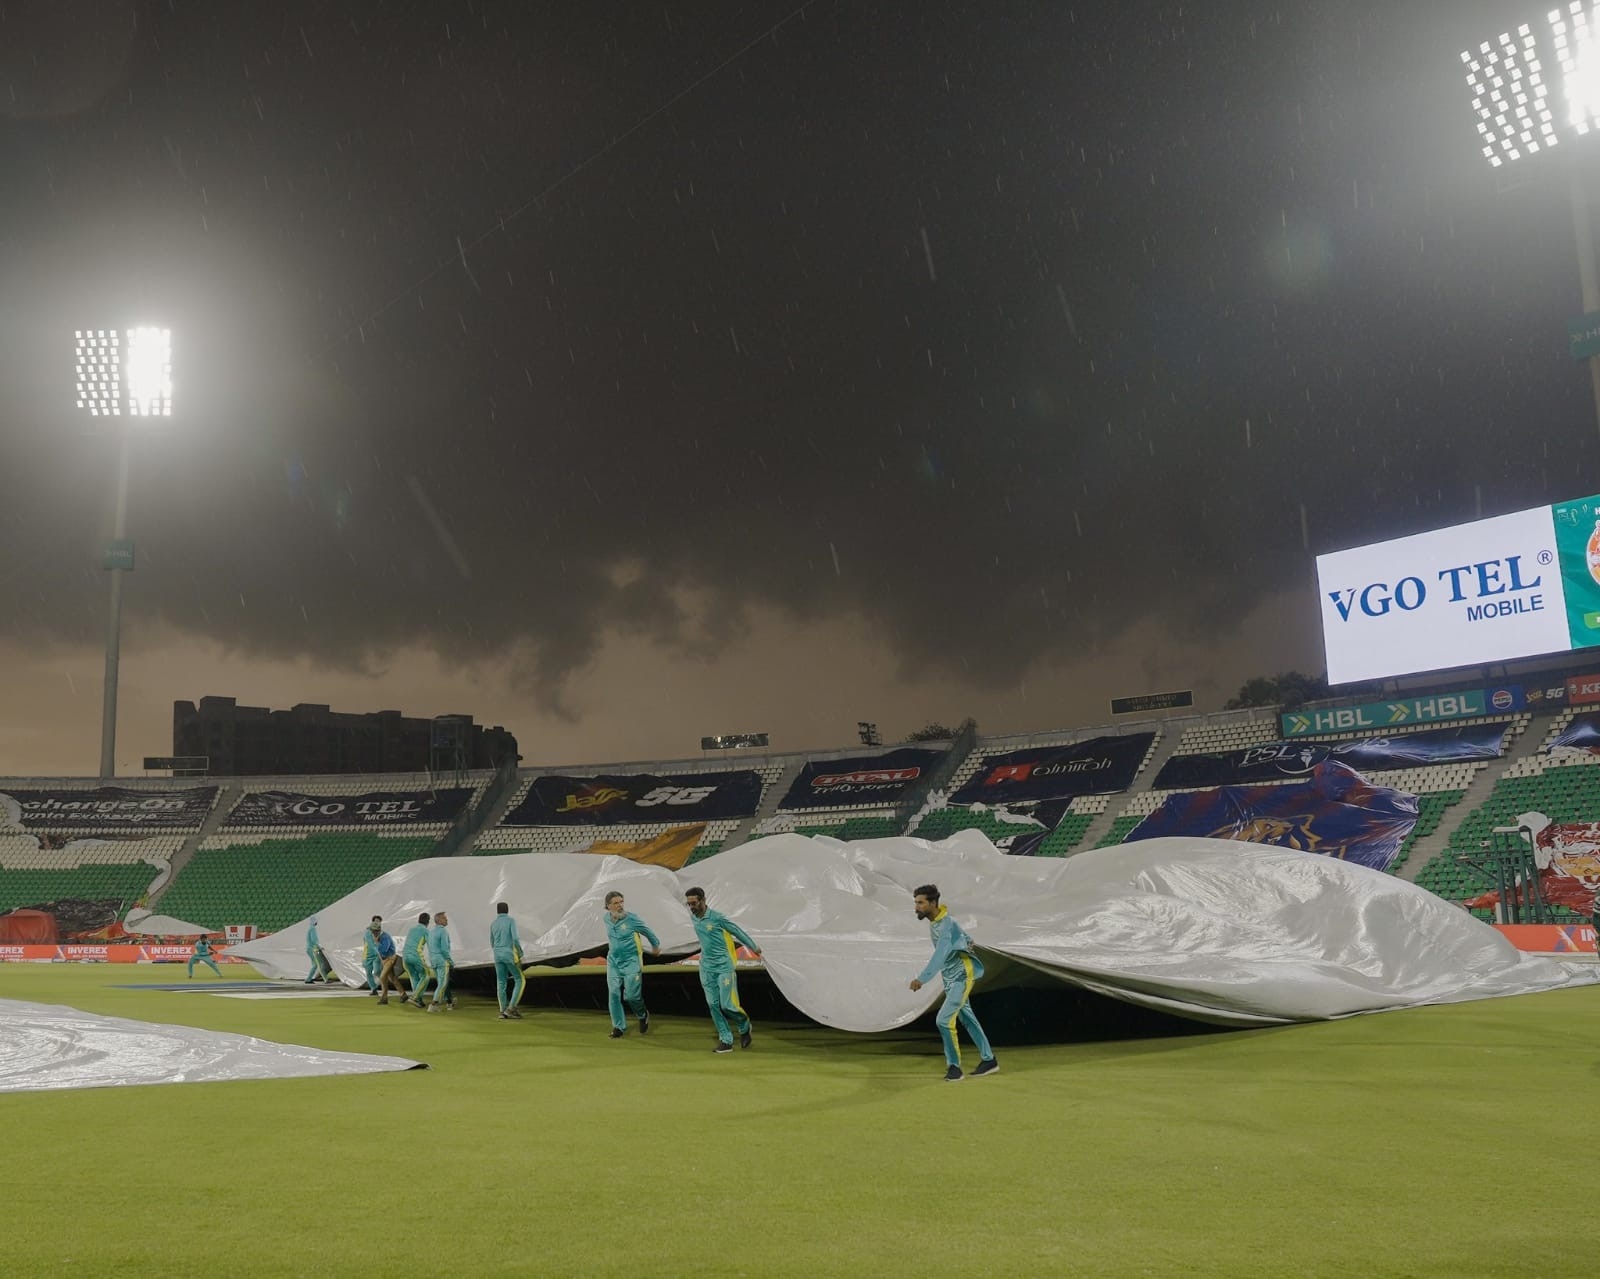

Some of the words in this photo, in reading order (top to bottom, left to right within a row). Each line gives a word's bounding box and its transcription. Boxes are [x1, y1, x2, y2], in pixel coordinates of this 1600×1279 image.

[1328, 576, 1427, 622] VGO
[1438, 555, 1541, 603] TEL
[1467, 594, 1544, 622] MOBILE
[1545, 687, 1565, 699] 5G
[1414, 695, 1478, 719] HBL
[1315, 708, 1374, 731] HBL
[1241, 745, 1297, 766] PSL
[815, 769, 916, 785] TAPAL
[355, 800, 422, 814] TEL
[635, 786, 718, 807] 5G
[67, 946, 108, 955] INVEREX
[151, 946, 192, 955] INVEREX
